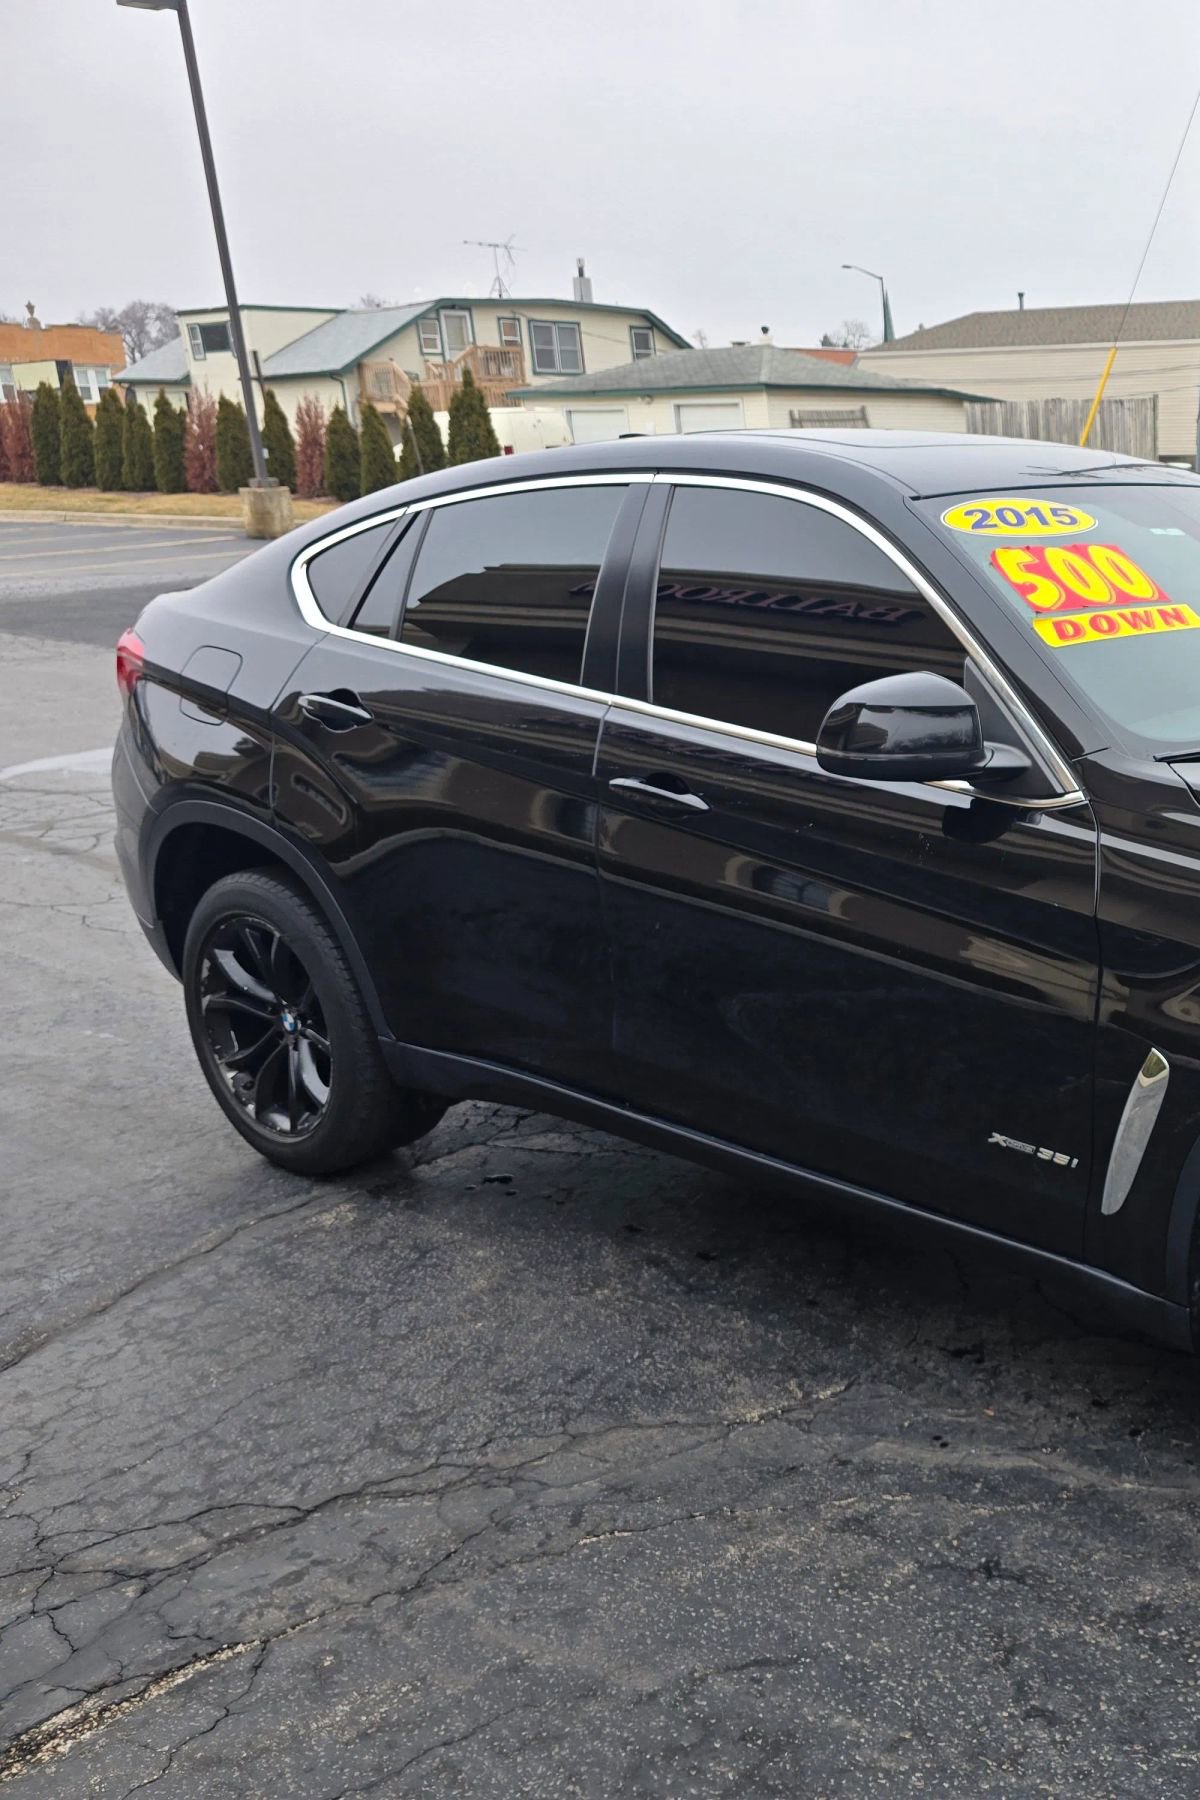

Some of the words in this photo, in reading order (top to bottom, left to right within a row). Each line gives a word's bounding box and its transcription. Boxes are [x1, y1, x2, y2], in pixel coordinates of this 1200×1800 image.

[963, 506, 1079, 530] 2015
[994, 545, 1159, 610] 500
[1052, 607, 1188, 641] DOWN
